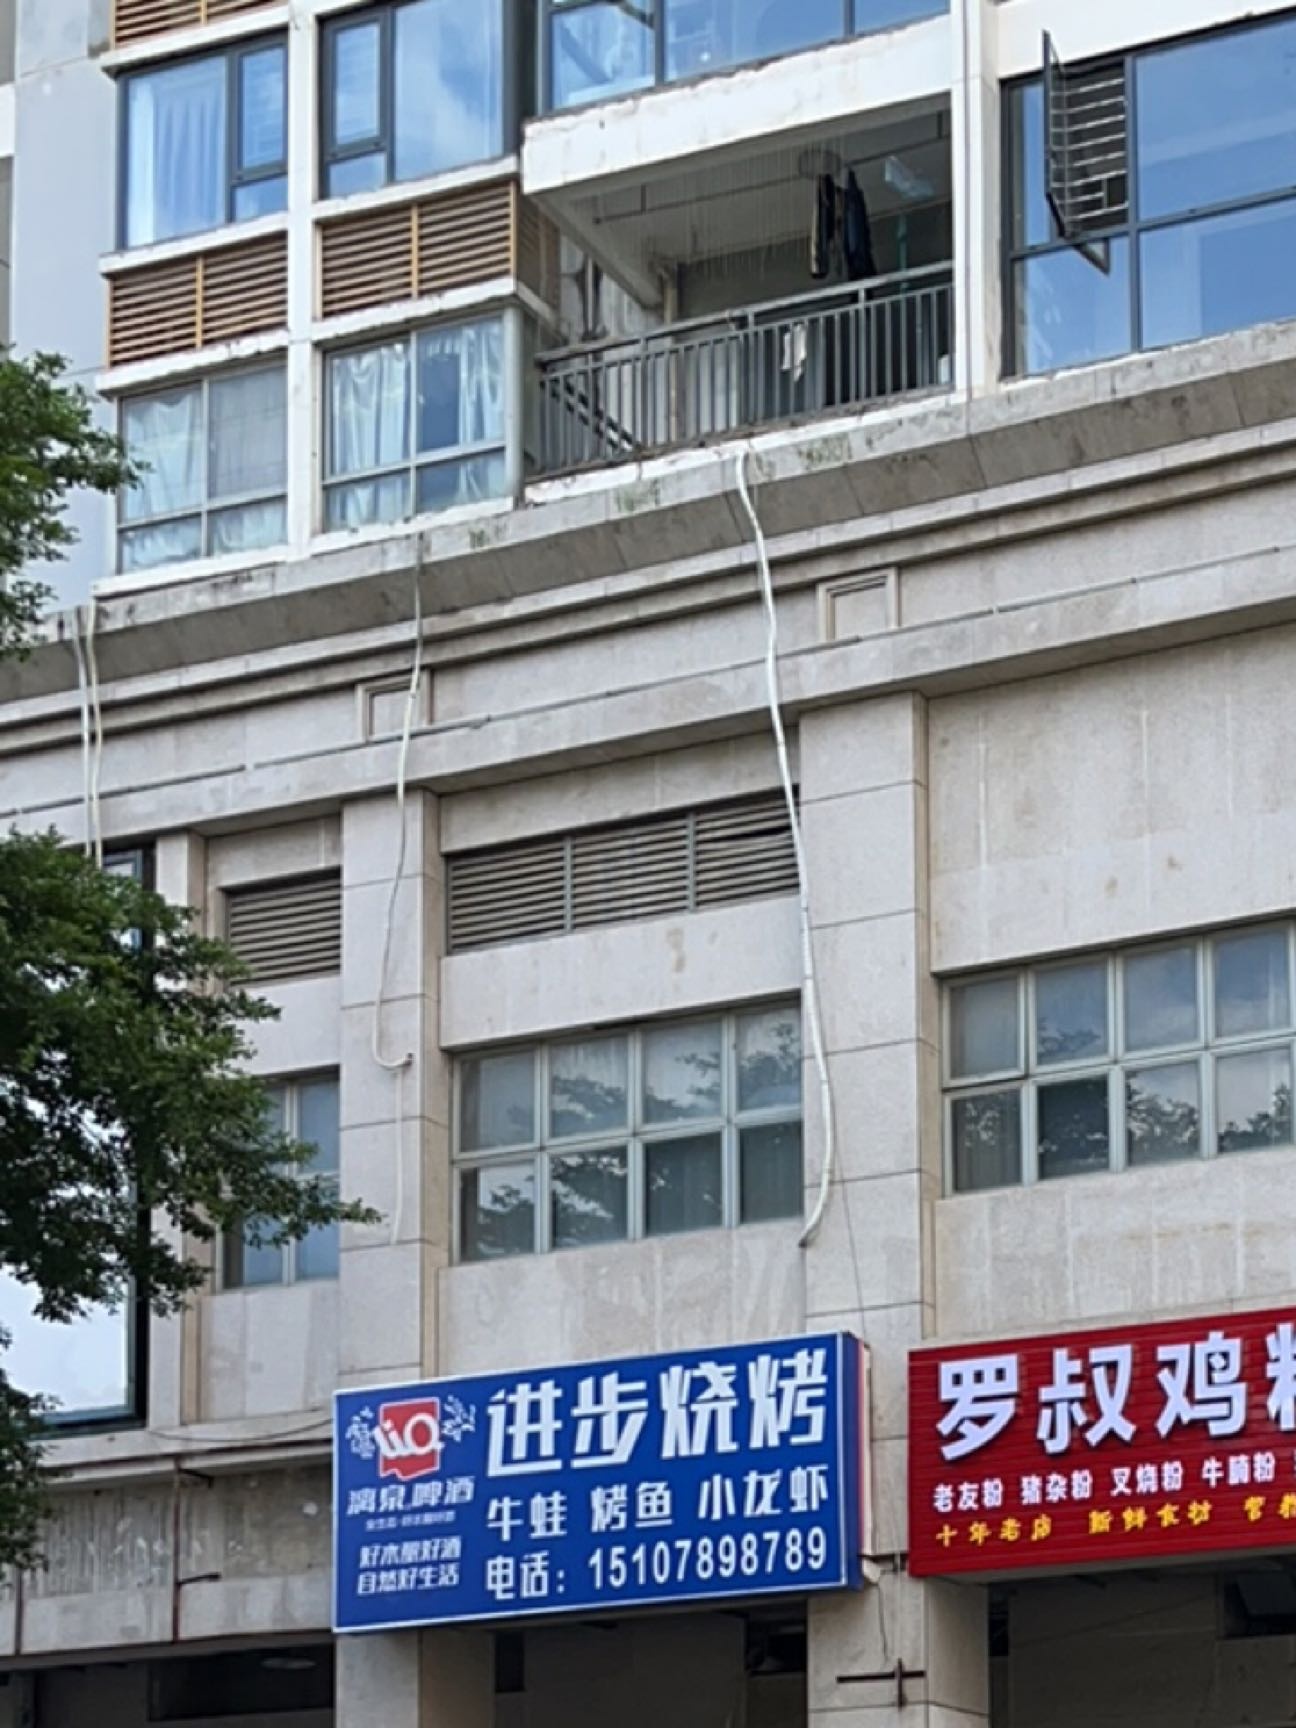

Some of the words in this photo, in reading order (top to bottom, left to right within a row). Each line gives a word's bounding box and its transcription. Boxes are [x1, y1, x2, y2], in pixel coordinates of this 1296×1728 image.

[486, 1347, 828, 1477] 进步烧烤
[486, 1491, 568, 1541] 牛蛙
[590, 1480, 674, 1534] 烤鱼
[698, 1465, 829, 1521] 小龙虾
[932, 1477, 1004, 1514] 老友粉
[1020, 1469, 1094, 1507] 猪杂粉
[1110, 1460, 1184, 1498] 叉烧粉
[1201, 1451, 1277, 1488] 牛腩粉
[588, 1526, 827, 1591] 15107898789
[935, 1513, 1054, 1549] 十年老店
[356, 1561, 461, 1596] 自然好生活
